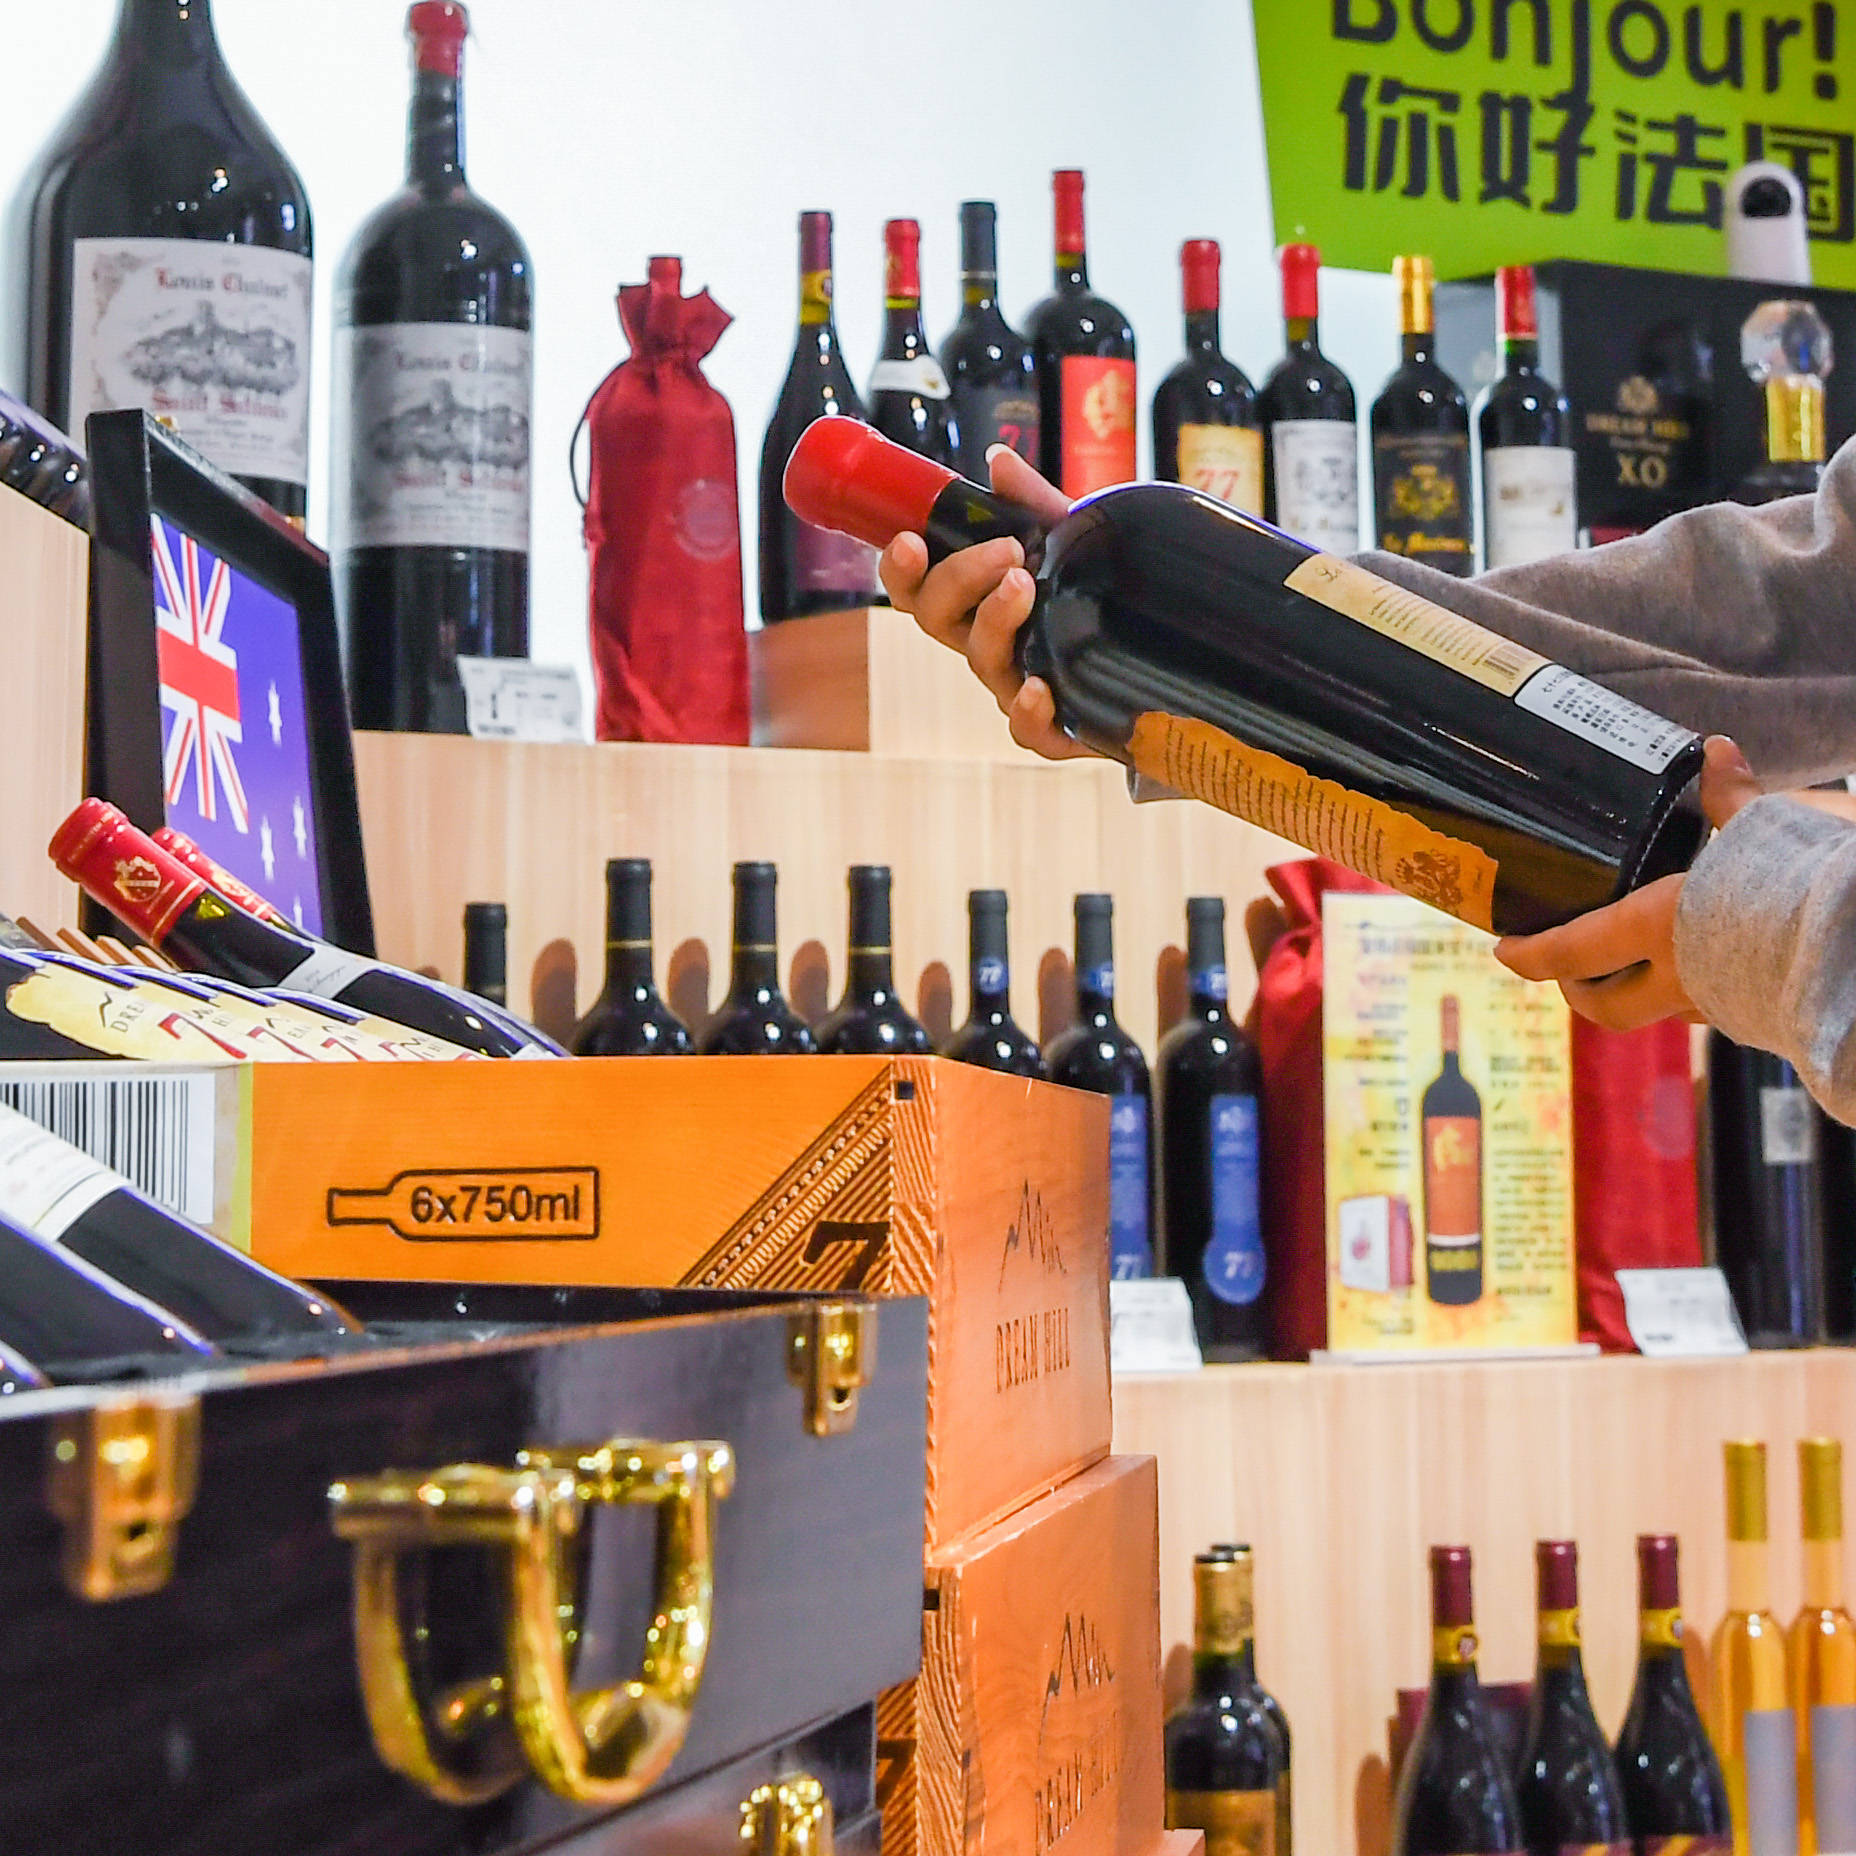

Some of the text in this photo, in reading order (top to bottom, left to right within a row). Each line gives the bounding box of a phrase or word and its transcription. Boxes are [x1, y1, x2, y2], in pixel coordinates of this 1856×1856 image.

[1337, 72, 1856, 244] 你好法国
[1194, 468, 1240, 501] 77
[1617, 454, 1668, 489] XO
[409, 1182, 581, 1228] 6x750ml
[996, 1306, 1070, 1394] DREAM HILL
